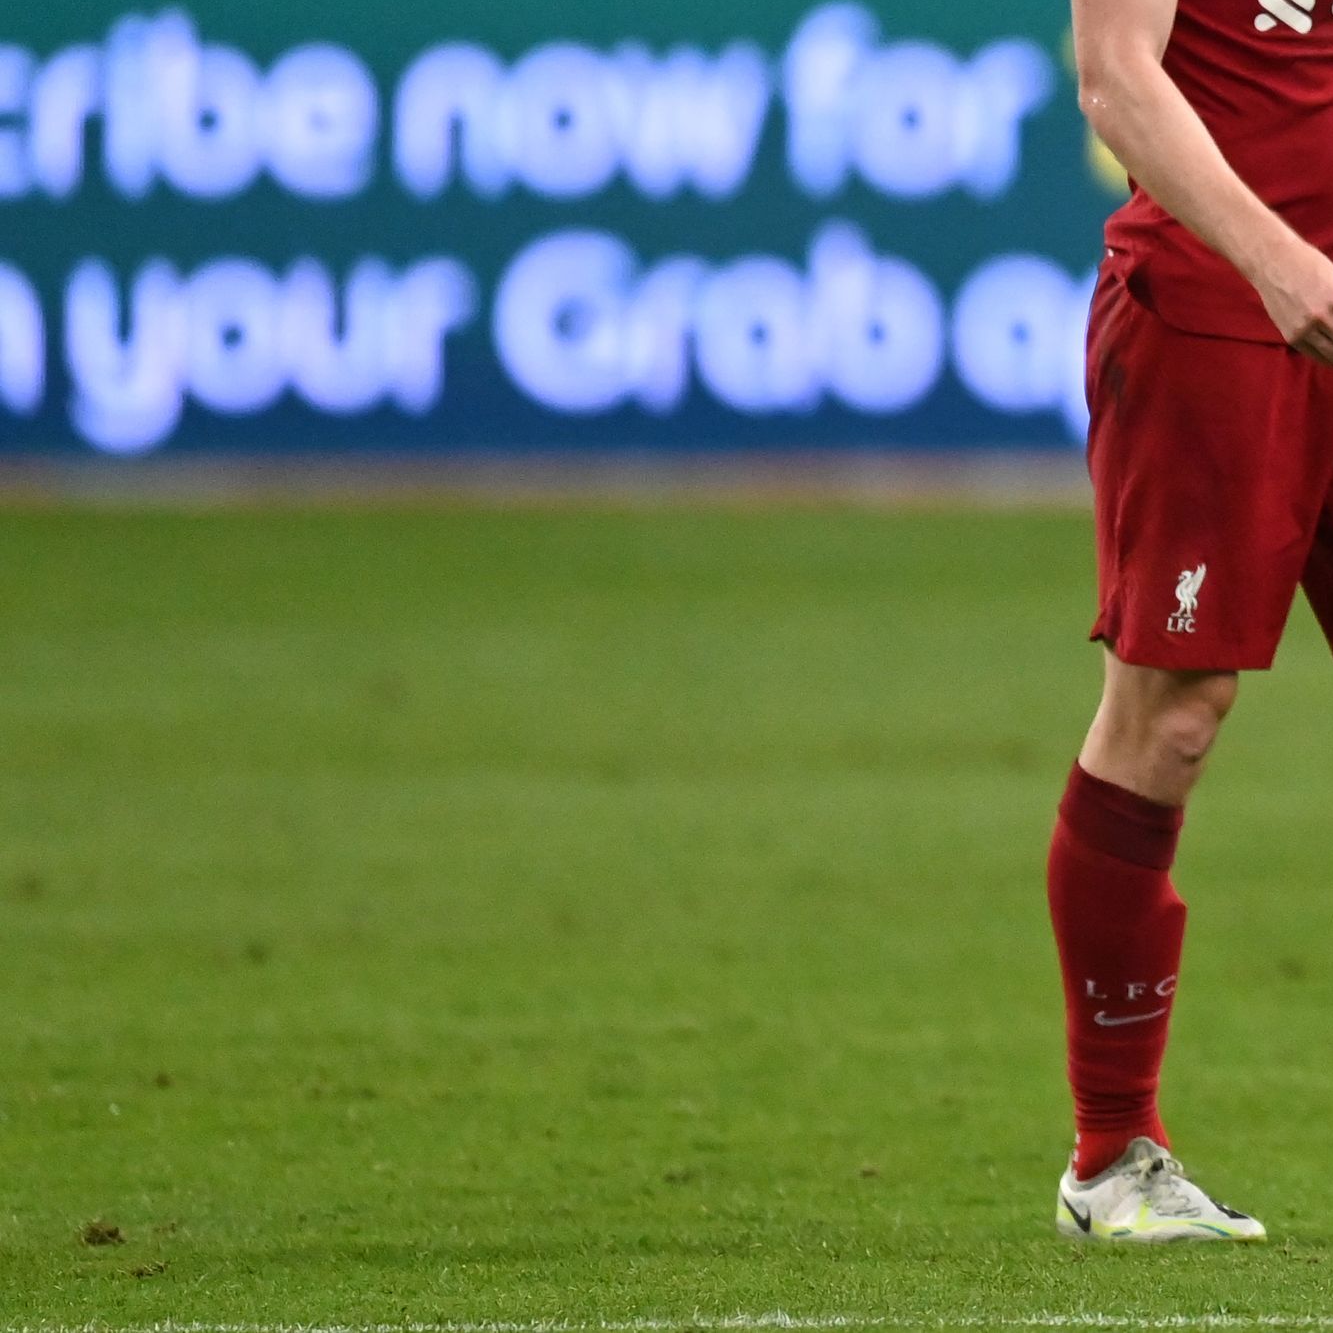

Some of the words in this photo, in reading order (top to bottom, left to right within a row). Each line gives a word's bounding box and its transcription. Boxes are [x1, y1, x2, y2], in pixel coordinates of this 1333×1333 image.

[393, 41, 768, 198] now
[784, 0, 1048, 198] for
[64, 257, 476, 454] your
[492, 227, 944, 414] Grab
